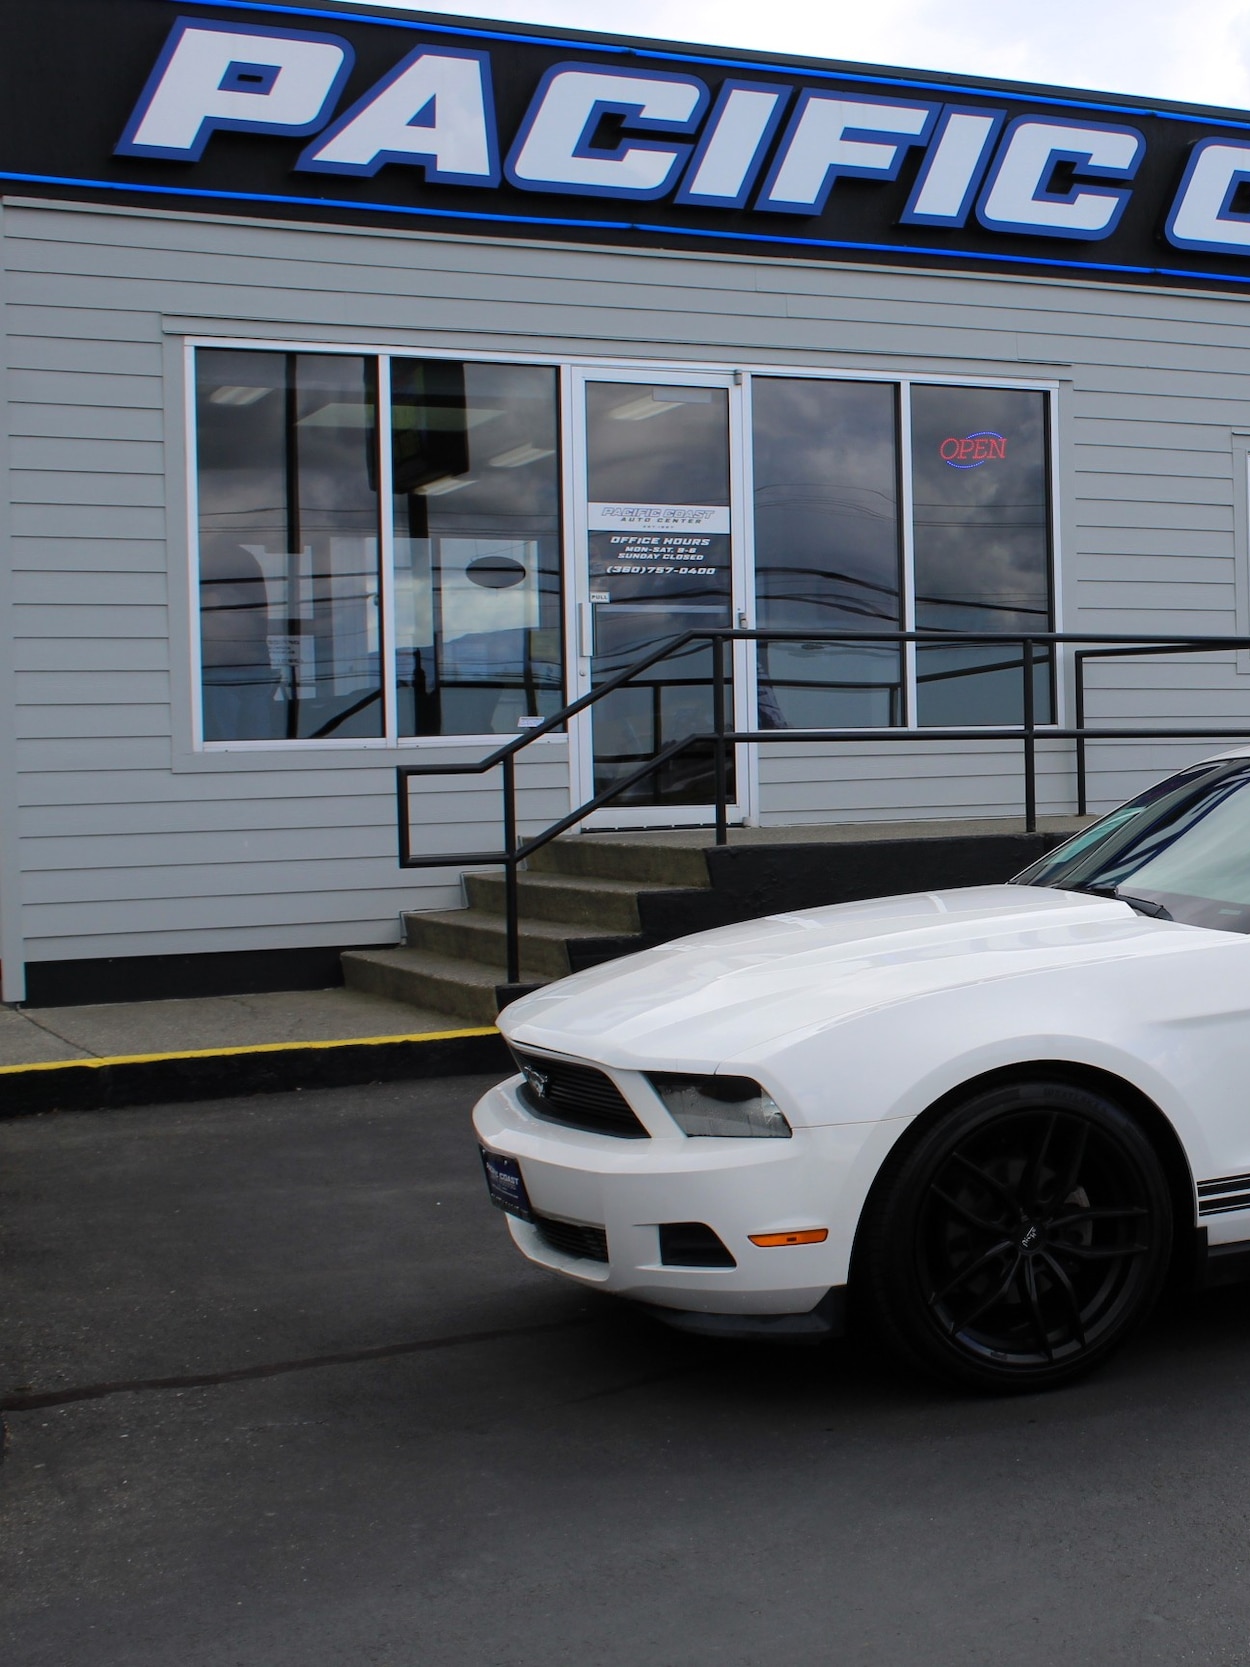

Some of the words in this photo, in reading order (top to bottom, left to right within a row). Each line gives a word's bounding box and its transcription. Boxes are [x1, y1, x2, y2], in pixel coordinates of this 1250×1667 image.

[114, 16, 1147, 240] PACIFIC
[940, 437, 1008, 460] OPEN
[601, 506, 663, 517] PACIFIC
[663, 508, 715, 520] COAST
[610, 536, 660, 545] OFFICE
[663, 537, 711, 546] HOURS
[617, 552, 660, 560] SUNDAY
